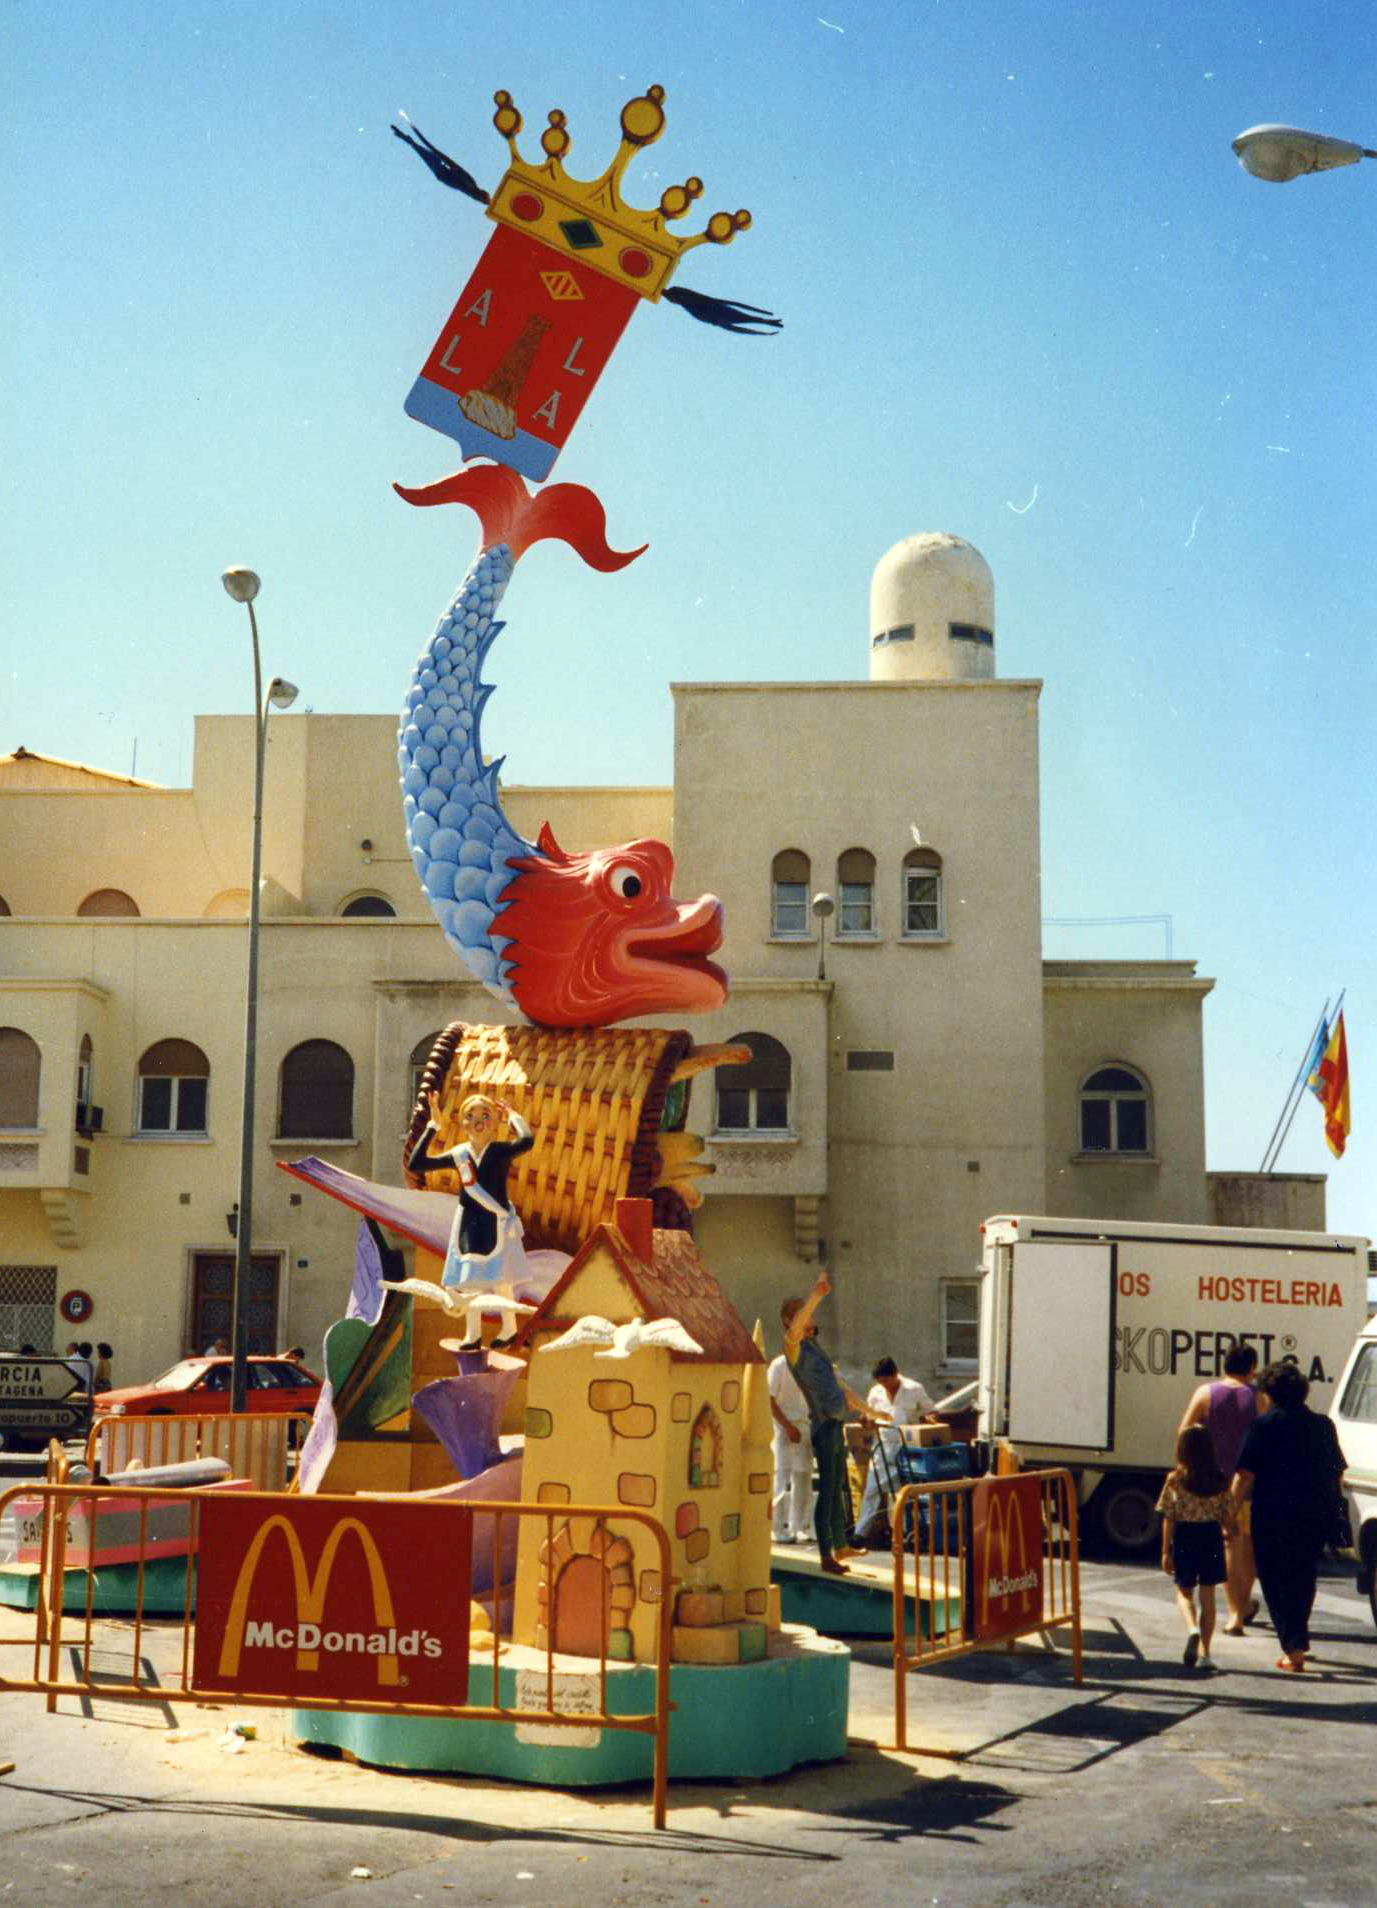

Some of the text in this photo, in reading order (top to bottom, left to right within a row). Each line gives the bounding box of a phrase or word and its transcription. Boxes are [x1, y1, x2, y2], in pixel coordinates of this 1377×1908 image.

[1114, 1272, 1344, 1308] OS HOSTELERIA
[244, 1620, 443, 1659] McDonald's
